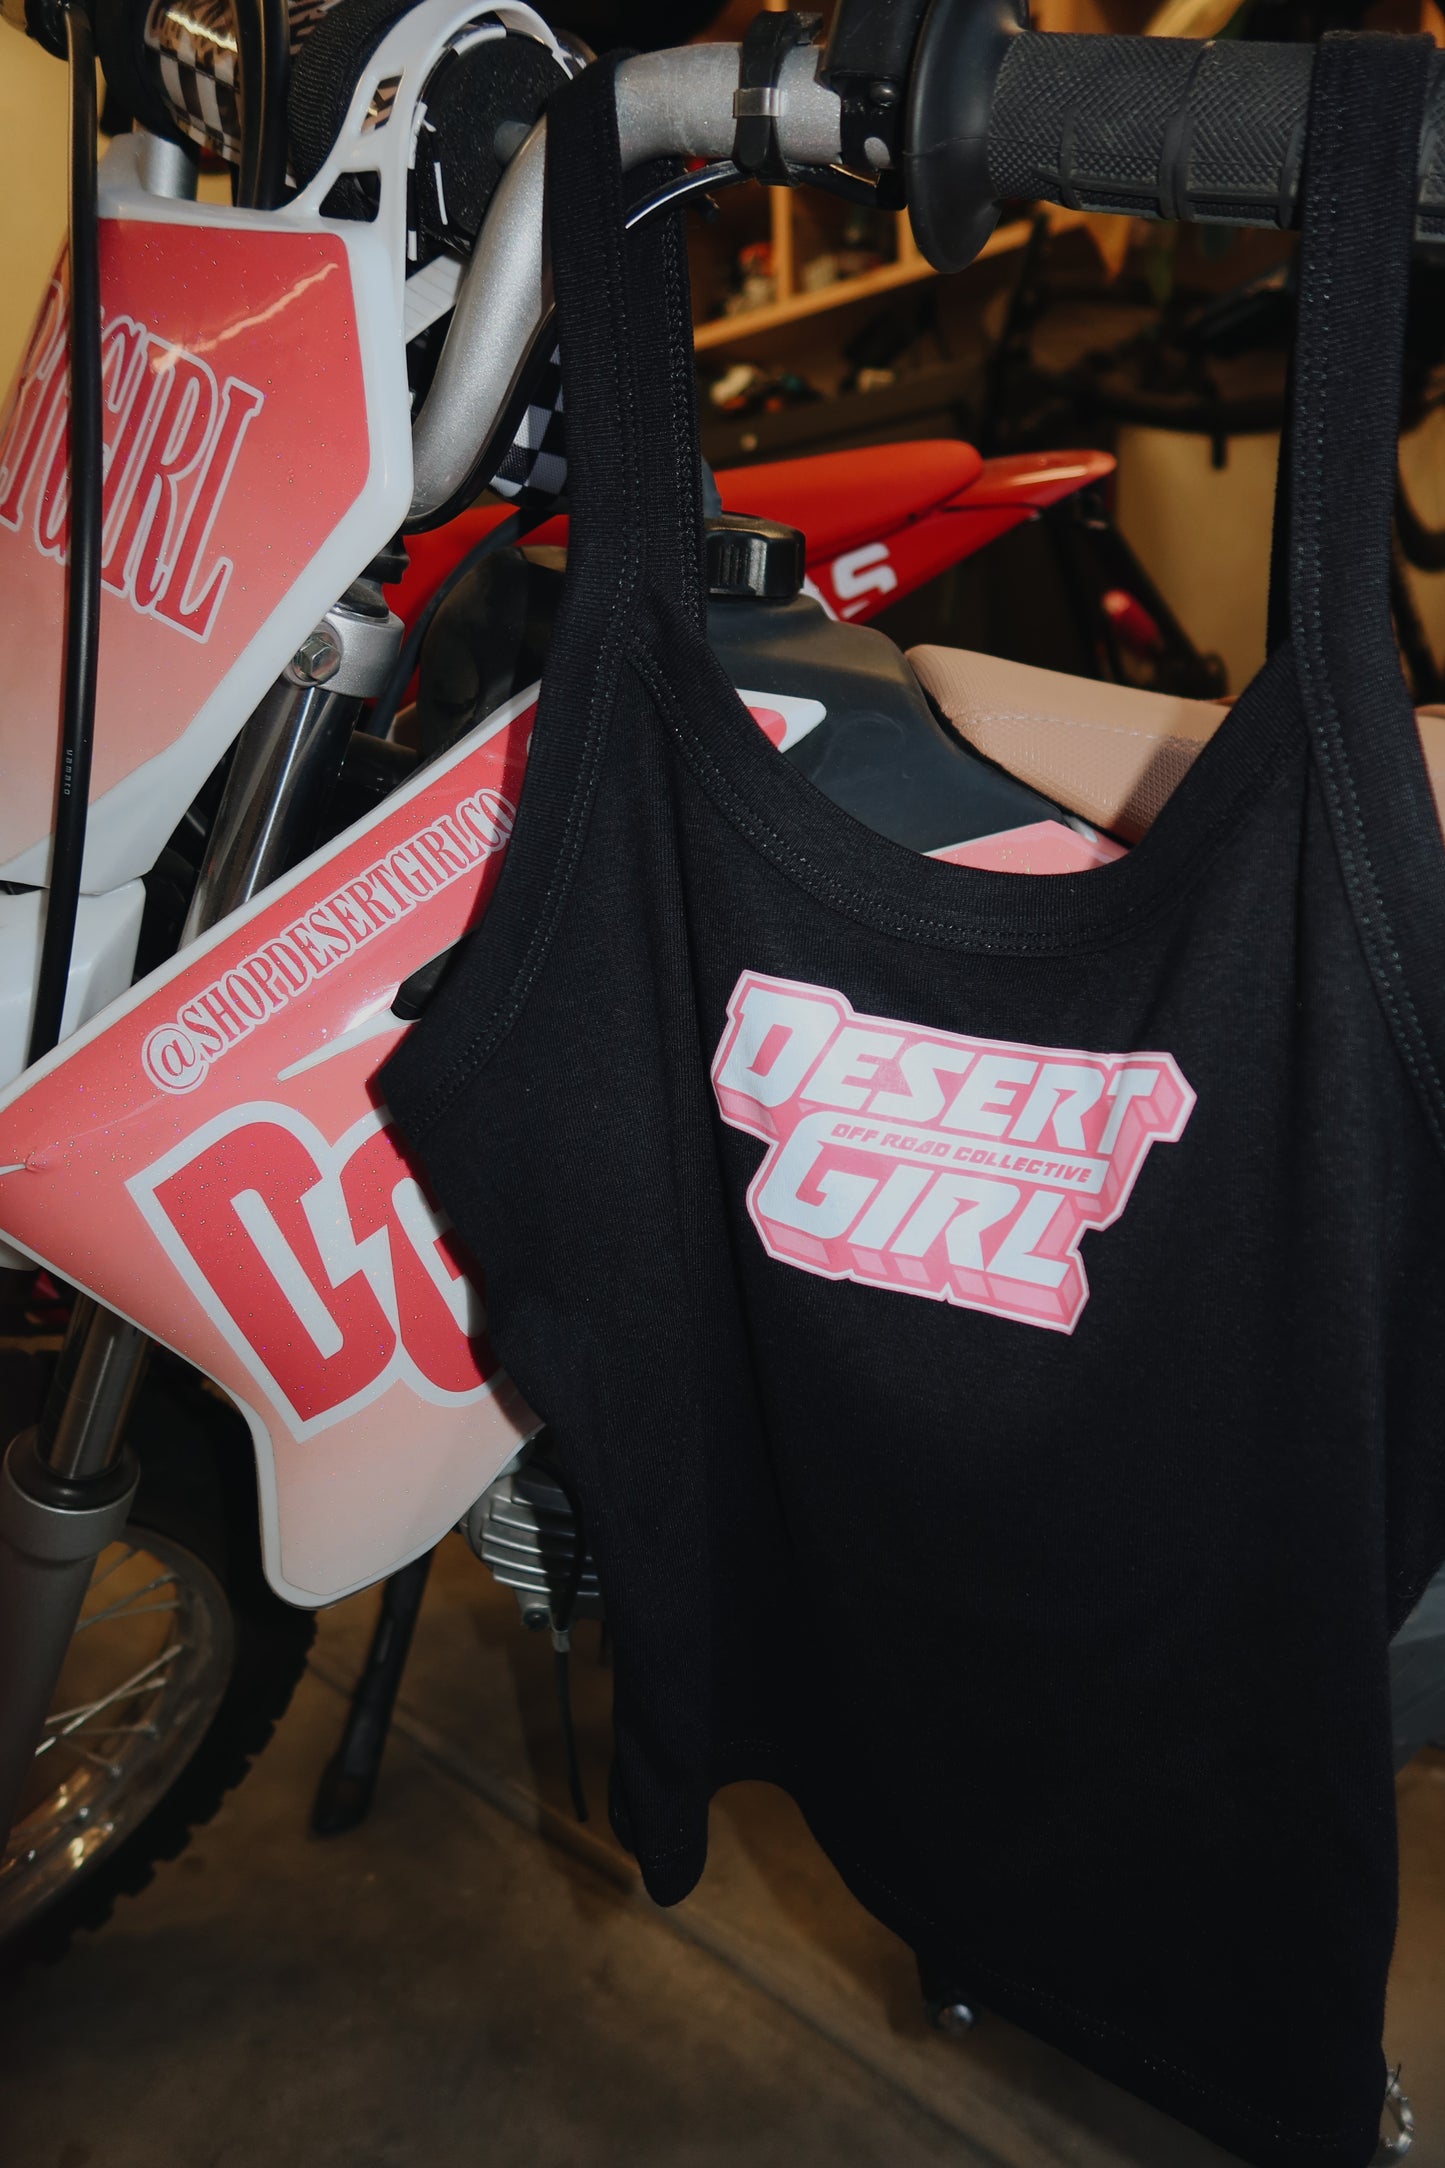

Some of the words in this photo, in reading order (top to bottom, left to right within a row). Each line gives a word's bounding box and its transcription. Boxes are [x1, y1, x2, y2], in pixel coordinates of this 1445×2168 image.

[0, 278, 264, 642] TGIRL
[143, 789, 517, 1093] @SHOPDESERTGIRLCO
[717, 986, 1140, 1156] DESERT
[831, 1123, 879, 1143] OFF
[880, 1132, 949, 1157] ROAD
[952, 1147, 1092, 1184] COLLECTIVE
[757, 1111, 1071, 1289] GIRL
